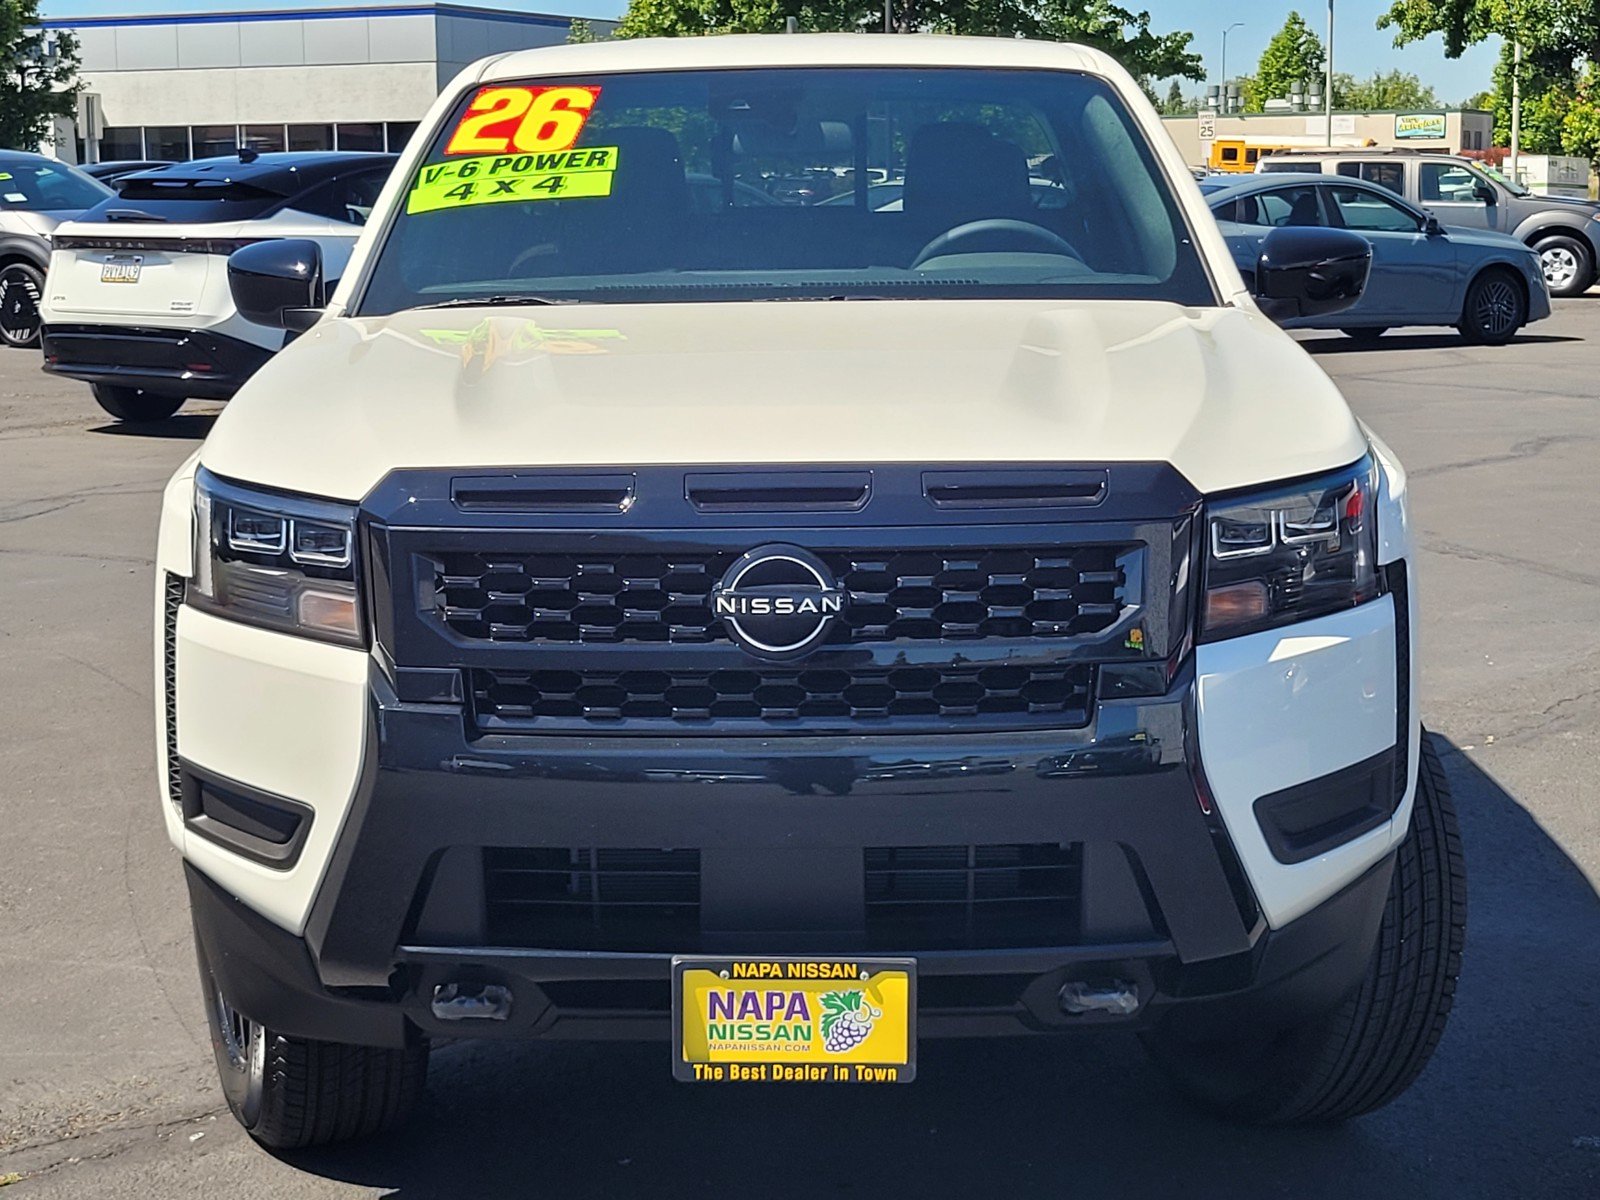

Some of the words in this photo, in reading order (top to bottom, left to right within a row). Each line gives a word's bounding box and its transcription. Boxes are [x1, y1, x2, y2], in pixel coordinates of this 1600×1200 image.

[447, 87, 594, 152] 26
[1200, 126, 1214, 137] 25
[425, 161, 480, 184] V-6
[488, 150, 610, 175] POWER
[443, 182, 475, 201] 4
[532, 176, 564, 193] 4
[88, 241, 145, 249] NISSAN
[716, 596, 841, 613] NISSAN
[733, 963, 783, 978] NAPA
[787, 963, 857, 978] NISSAN
[709, 991, 811, 1021] NAPA
[708, 1024, 812, 1041] NISSAN
[708, 1043, 811, 1052] NAPANISSAN.COM
[693, 1064, 723, 1080] The
[729, 1064, 766, 1080] Best
[772, 1064, 828, 1081] Dealer
[833, 1064, 849, 1081] in
[855, 1065, 897, 1081] Town
